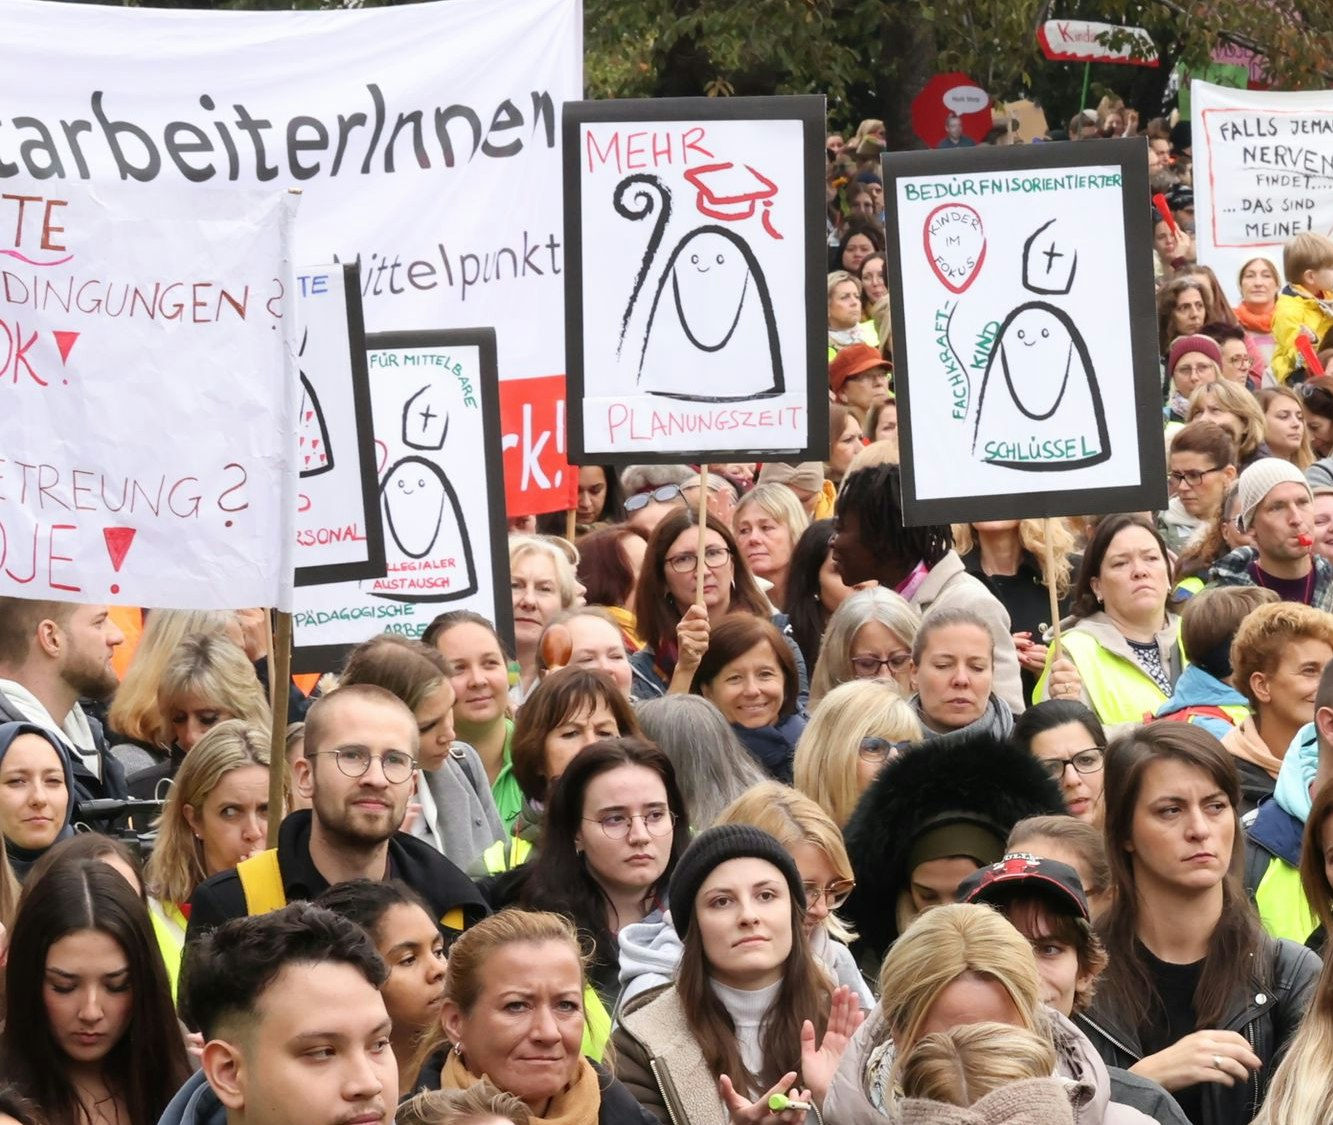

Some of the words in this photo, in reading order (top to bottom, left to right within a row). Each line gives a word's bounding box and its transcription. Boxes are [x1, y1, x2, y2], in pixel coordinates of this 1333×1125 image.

[1220, 118, 1278, 140] FALLS
[586, 127, 714, 173] MEHR
[1282, 198, 1315, 211] SIND
[928, 211, 981, 236] KINDER
[945, 235, 961, 247] IM
[934, 255, 976, 277] FOKUS
[970, 321, 1000, 370] KIND
[608, 403, 803, 444] PLANUNGSZEIT
[984, 436, 1097, 461] SCHLÜSSEL
[0, 459, 249, 527] TREUNG?
